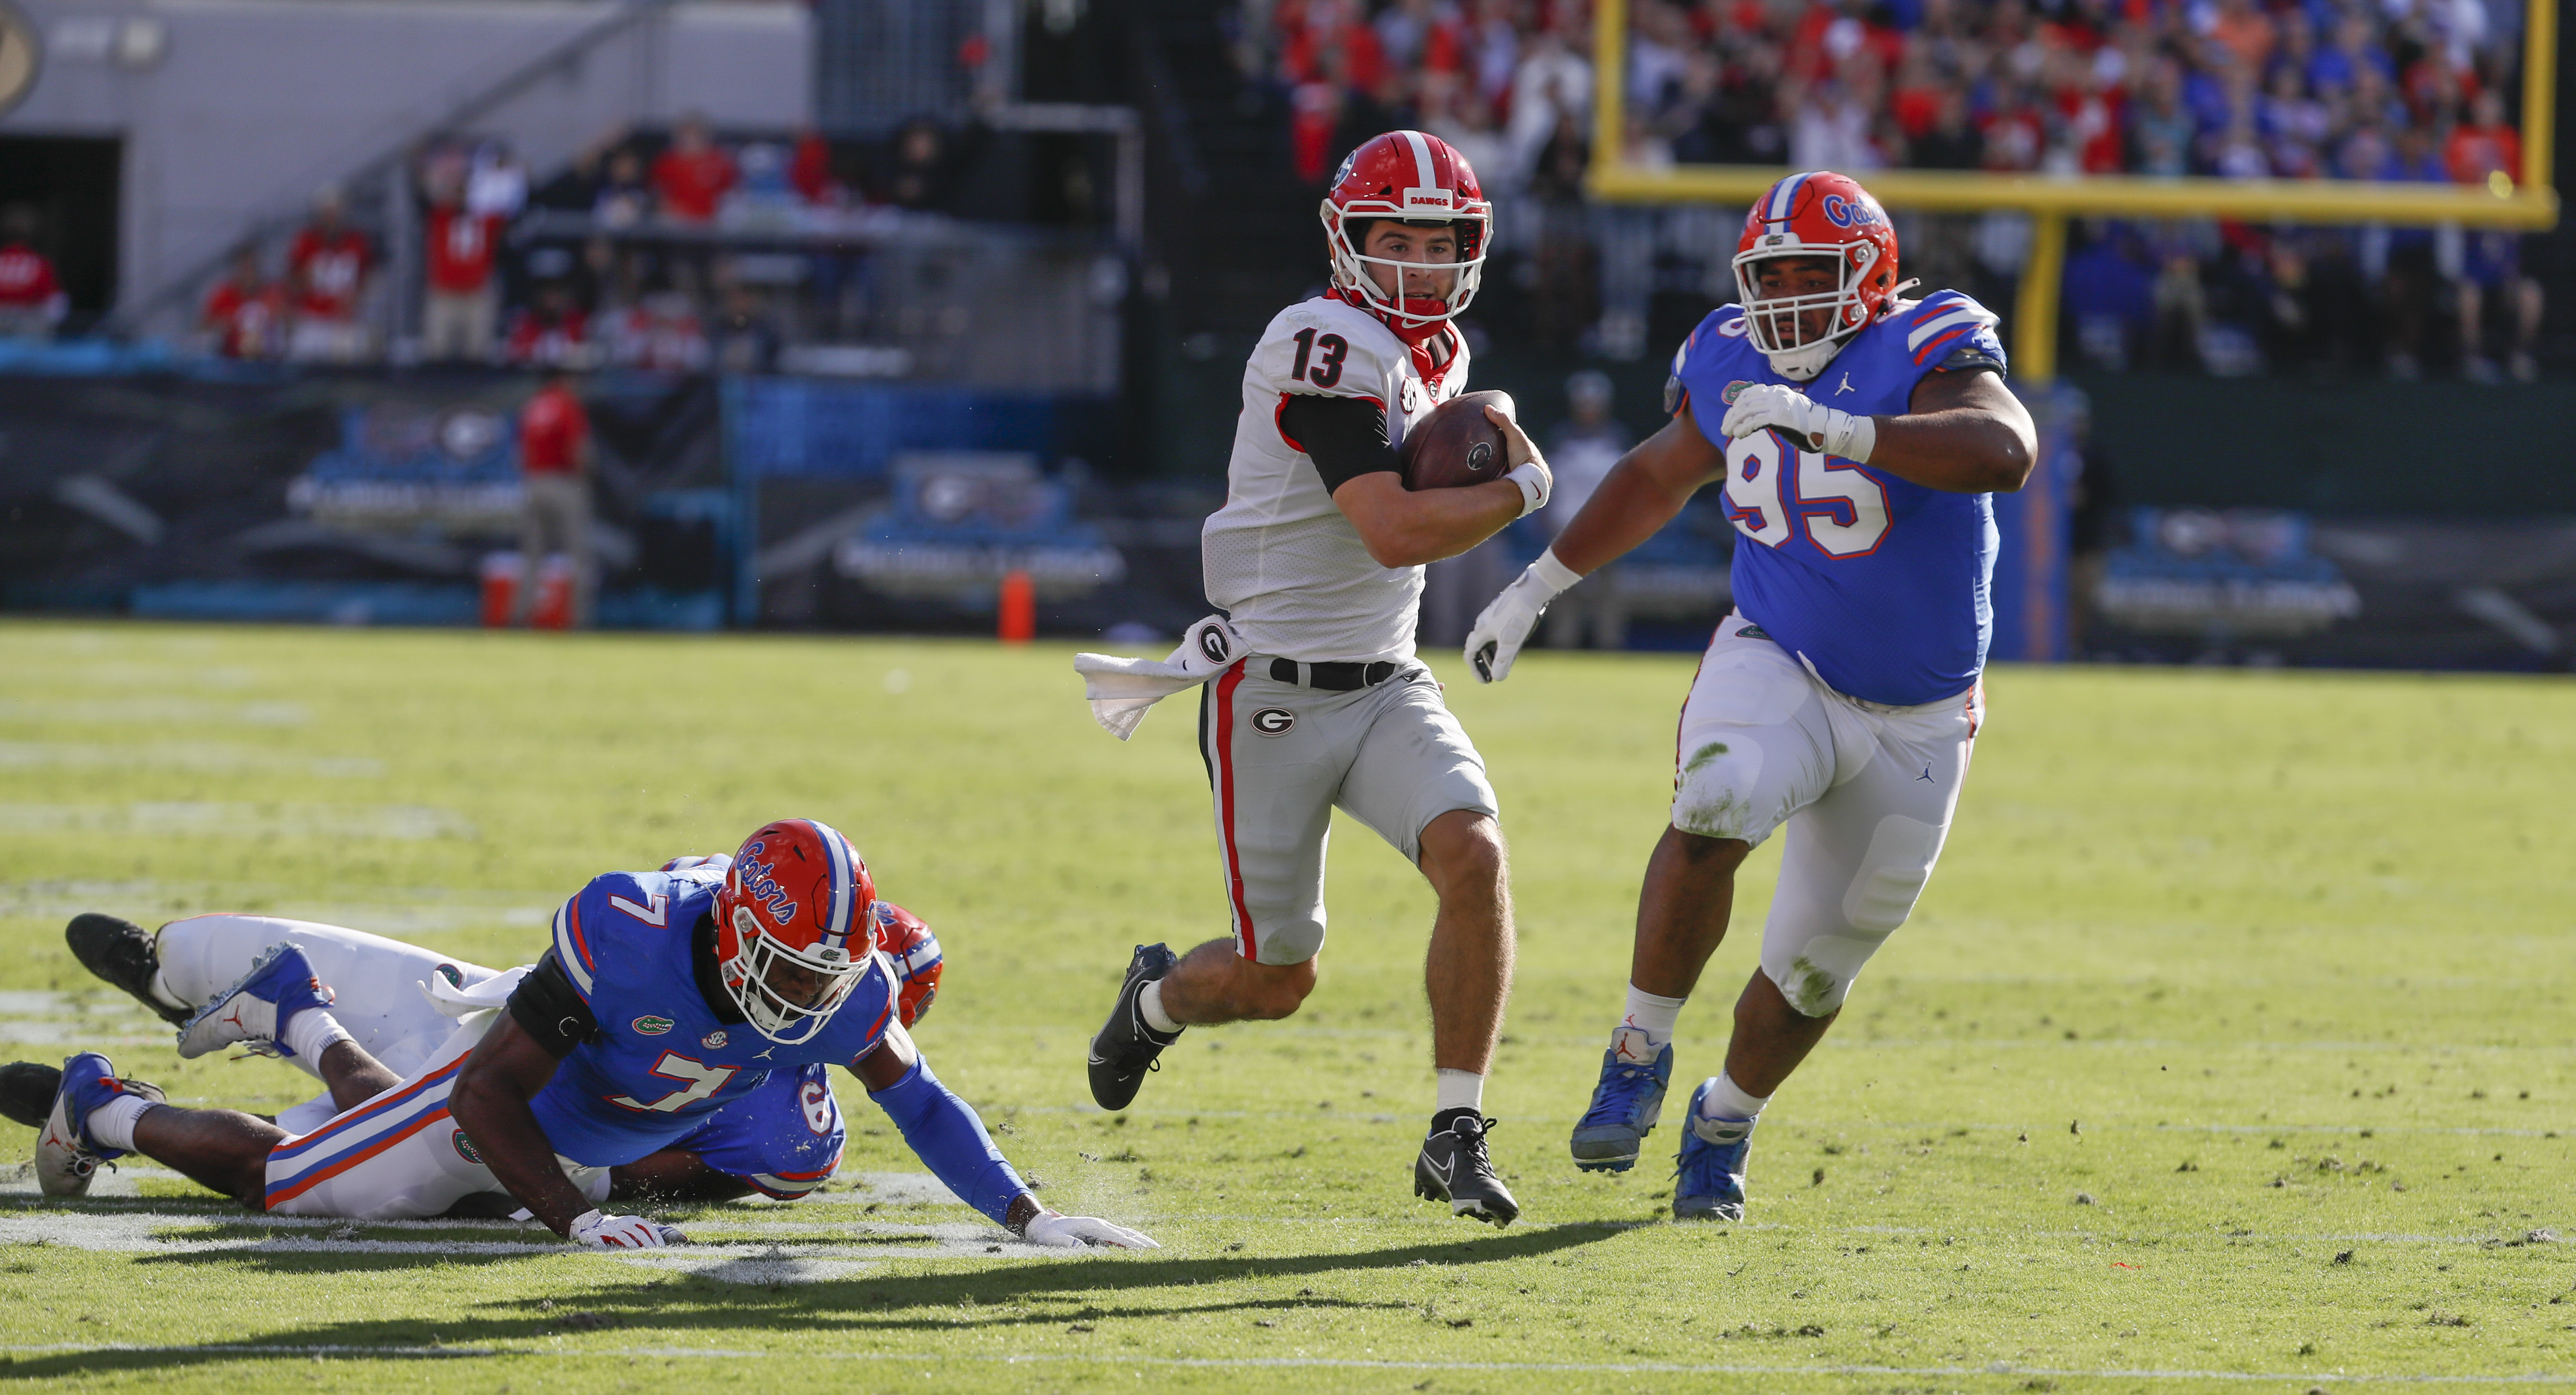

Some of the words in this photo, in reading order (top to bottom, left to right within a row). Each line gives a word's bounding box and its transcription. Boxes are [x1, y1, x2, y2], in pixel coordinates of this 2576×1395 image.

[1410, 196, 1449, 206] DAWGS
[1823, 194, 1894, 230] Gat
[1291, 327, 1348, 388] 13
[1428, 381, 1438, 399] G
[1724, 426, 1894, 560] 95
[1199, 624, 1230, 664] G
[1251, 708, 1295, 734] G
[736, 842, 797, 925] Gators
[608, 892, 669, 929] 7
[708, 1031, 726, 1044] SEC
[602, 1049, 742, 1113] 7
[800, 1080, 833, 1137] 6
